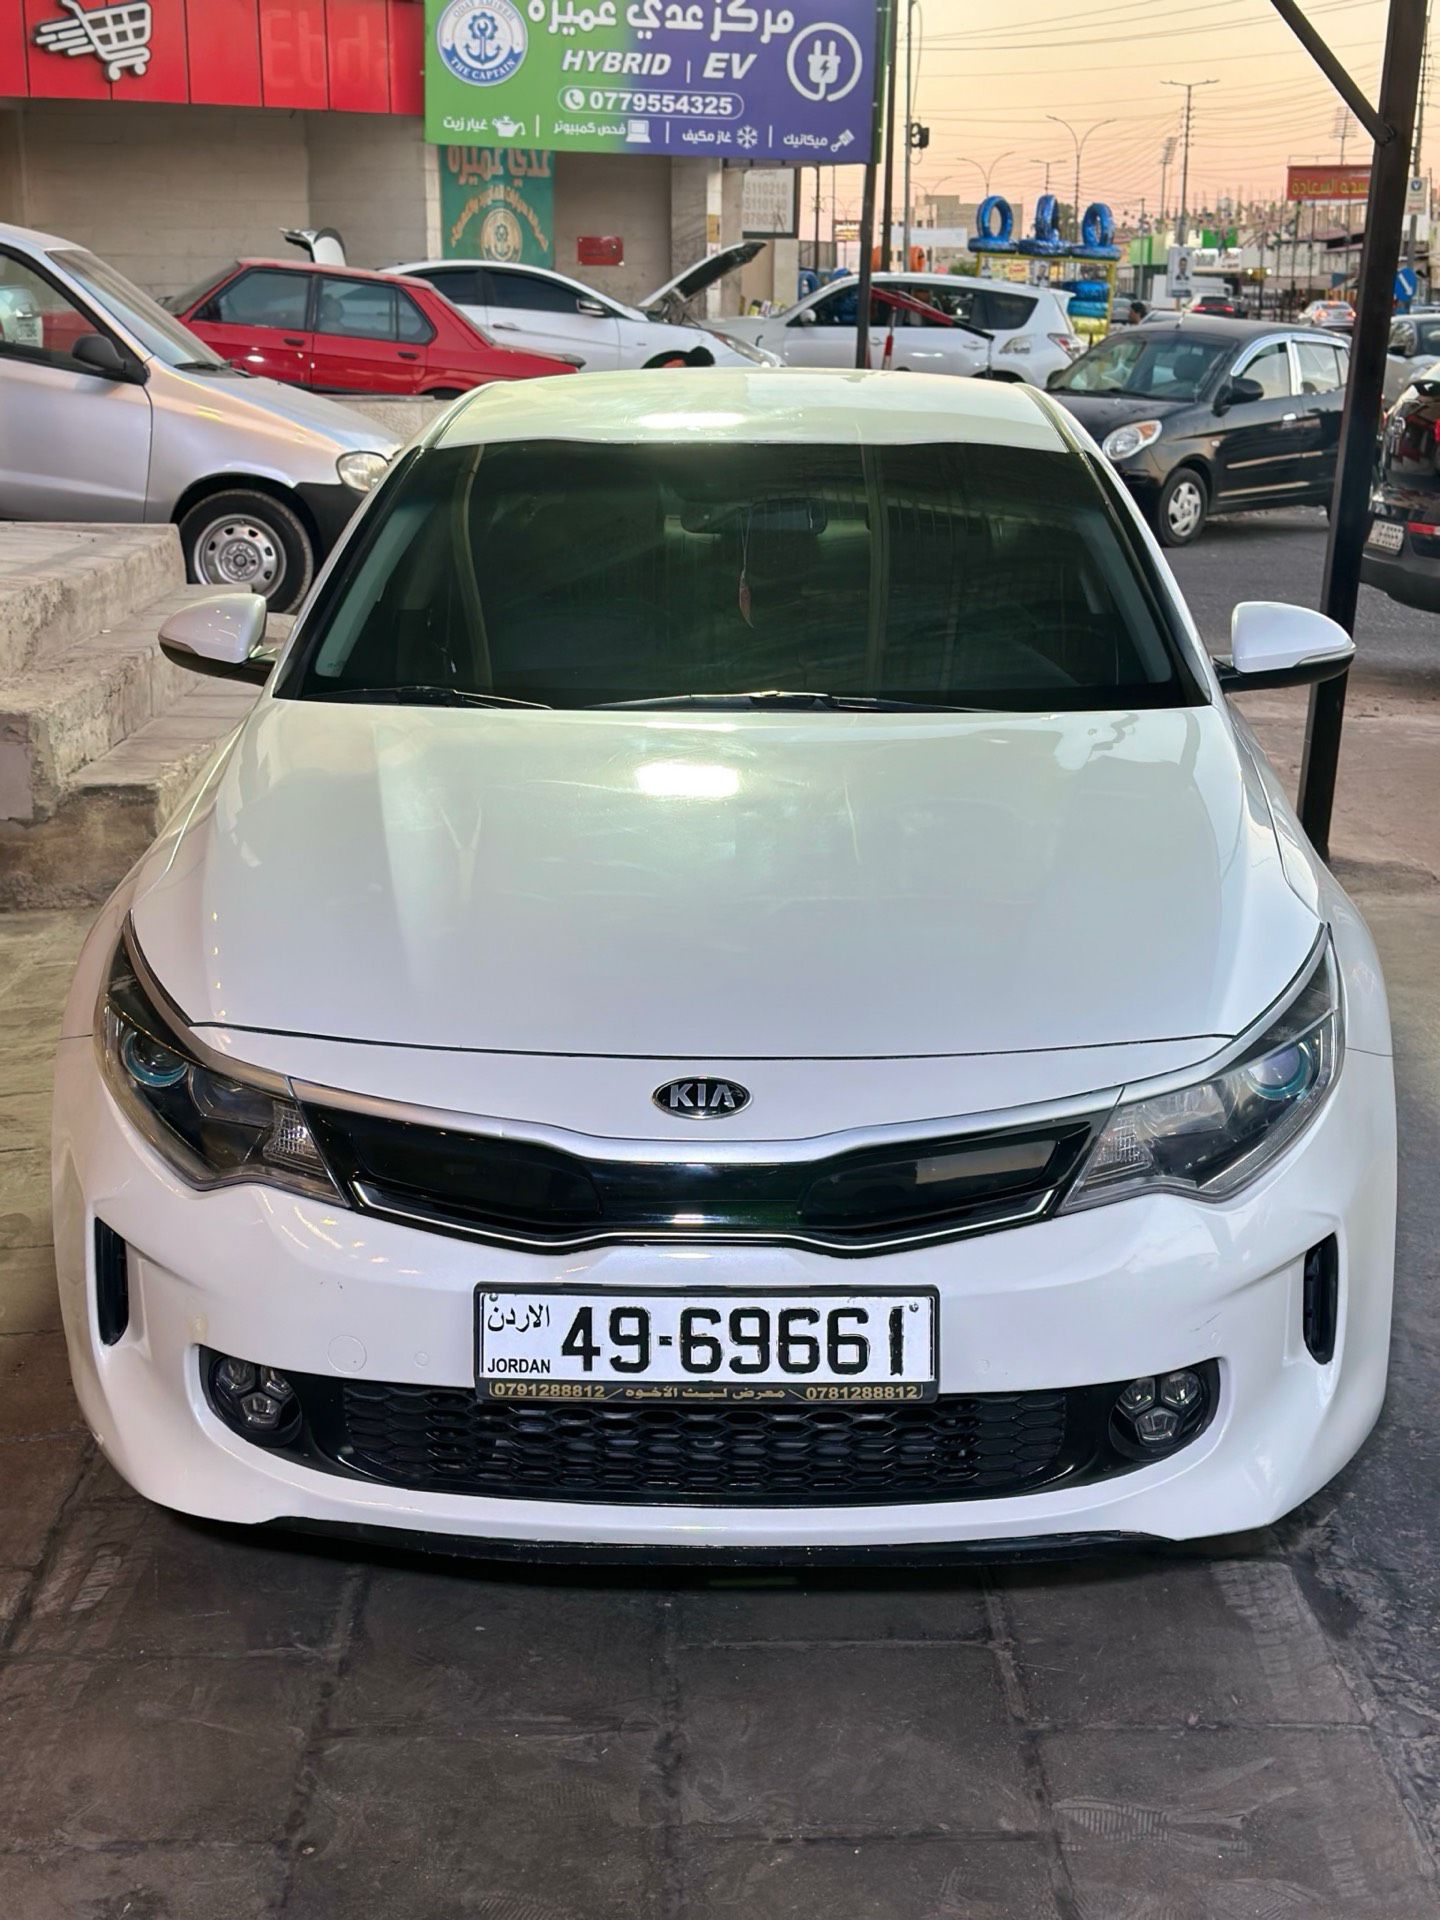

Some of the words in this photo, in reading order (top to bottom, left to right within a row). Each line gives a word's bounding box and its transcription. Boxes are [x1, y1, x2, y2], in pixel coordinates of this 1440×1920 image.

[626, 0, 704, 40] عدي
[709, 0, 795, 43] مركز
[451, 57, 471, 76] THE
[471, 59, 516, 80] CAPTAIN
[561, 49, 672, 76] HYBRID
[702, 52, 758, 79] EV
[589, 91, 733, 115] 0779554325
[443, 115, 466, 132] زيت
[466, 117, 488, 132] غيار
[553, 119, 596, 135] كمبيوتر
[597, 121, 627, 137] فحص
[682, 128, 715, 145] مكيف
[716, 128, 733, 145] غاز
[783, 132, 829, 149] ميكانيك
[669, 1083, 736, 1108] KIA
[487, 1358, 551, 1374] JORDAN
[494, 1383, 606, 1398] 0791288812
[732, 1387, 786, 1400] معرض
[805, 1386, 918, 1400] 0781288812
